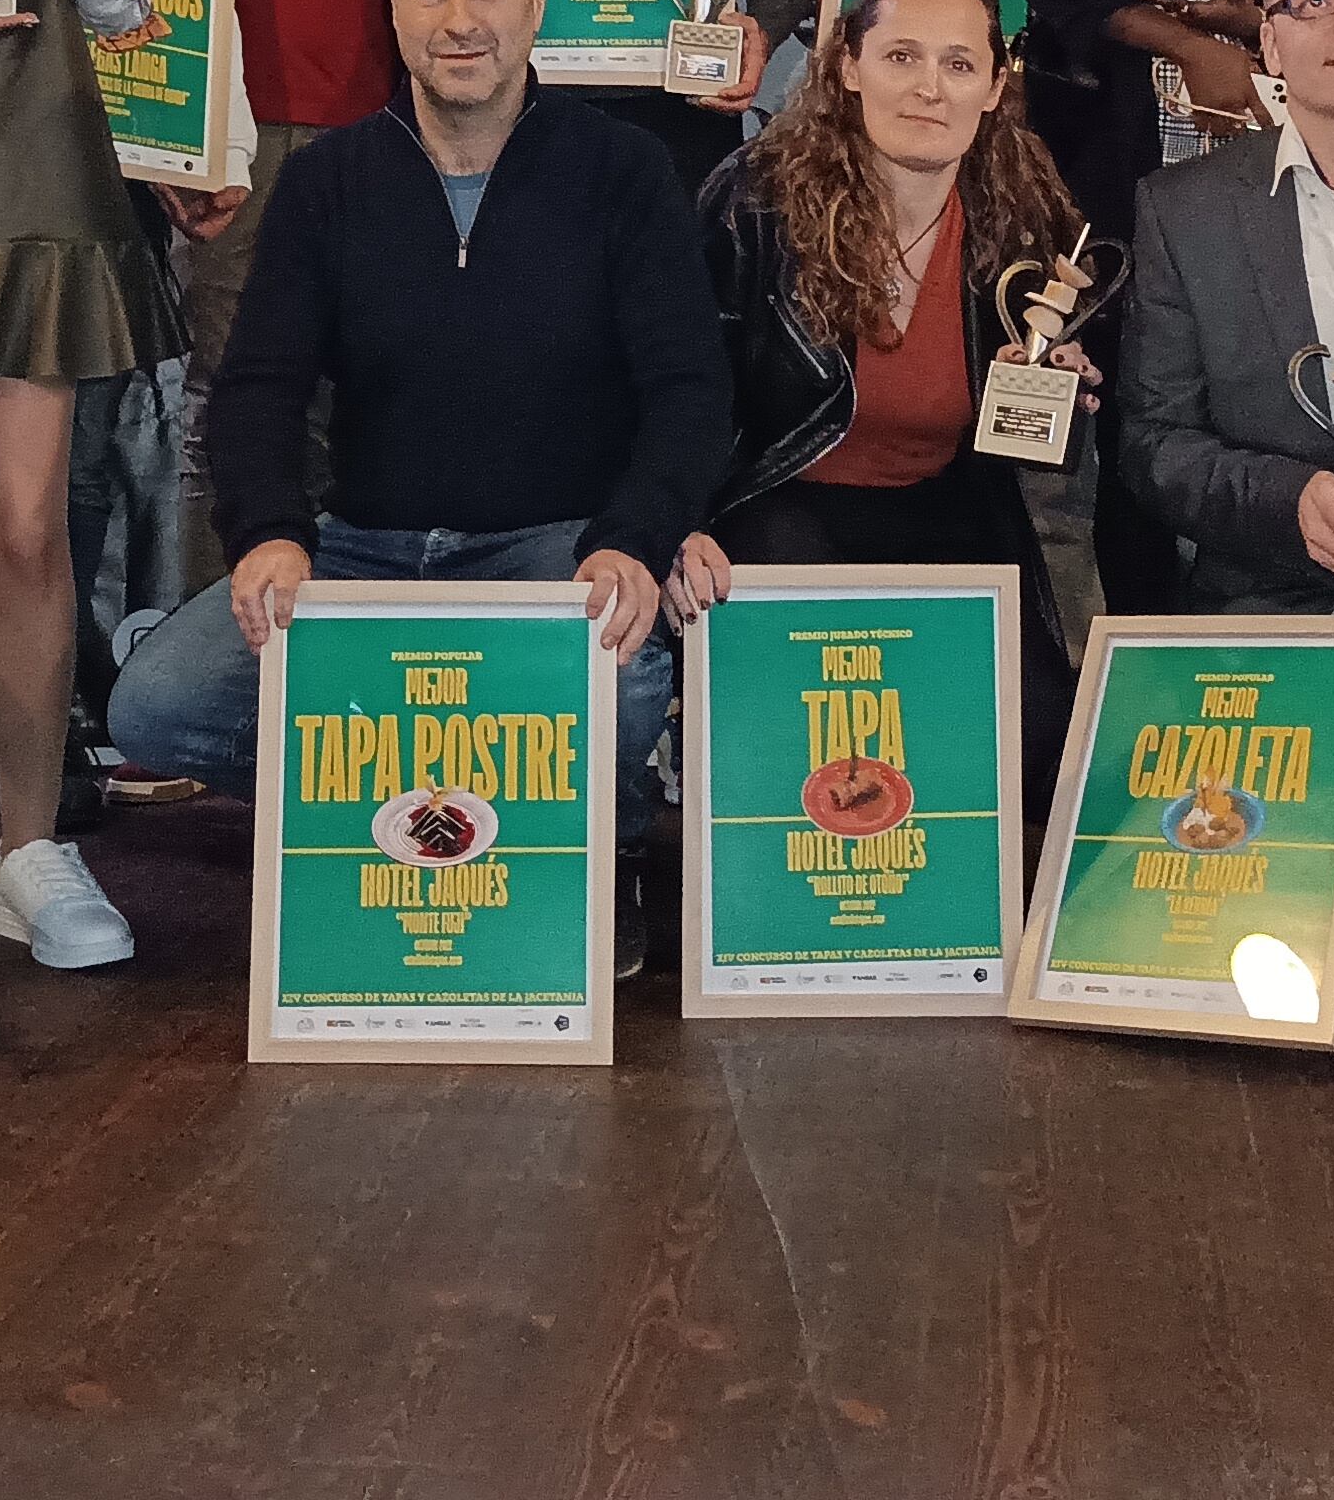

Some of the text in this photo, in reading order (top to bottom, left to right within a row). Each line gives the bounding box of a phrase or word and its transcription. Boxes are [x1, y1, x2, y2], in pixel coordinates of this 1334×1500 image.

[405, 667, 468, 705] MEJOR
[822, 645, 882, 681] MEJOR
[801, 688, 906, 772] TAPA
[1201, 687, 1259, 719] MEJOR
[295, 713, 577, 802] TAPA POSTRE
[1128, 725, 1312, 803] CAZOLETA
[787, 820, 926, 874] HOTEL JAQUÉS
[1132, 851, 1190, 890] HOTEL
[360, 854, 508, 911] HOTEL JAQUÉS
